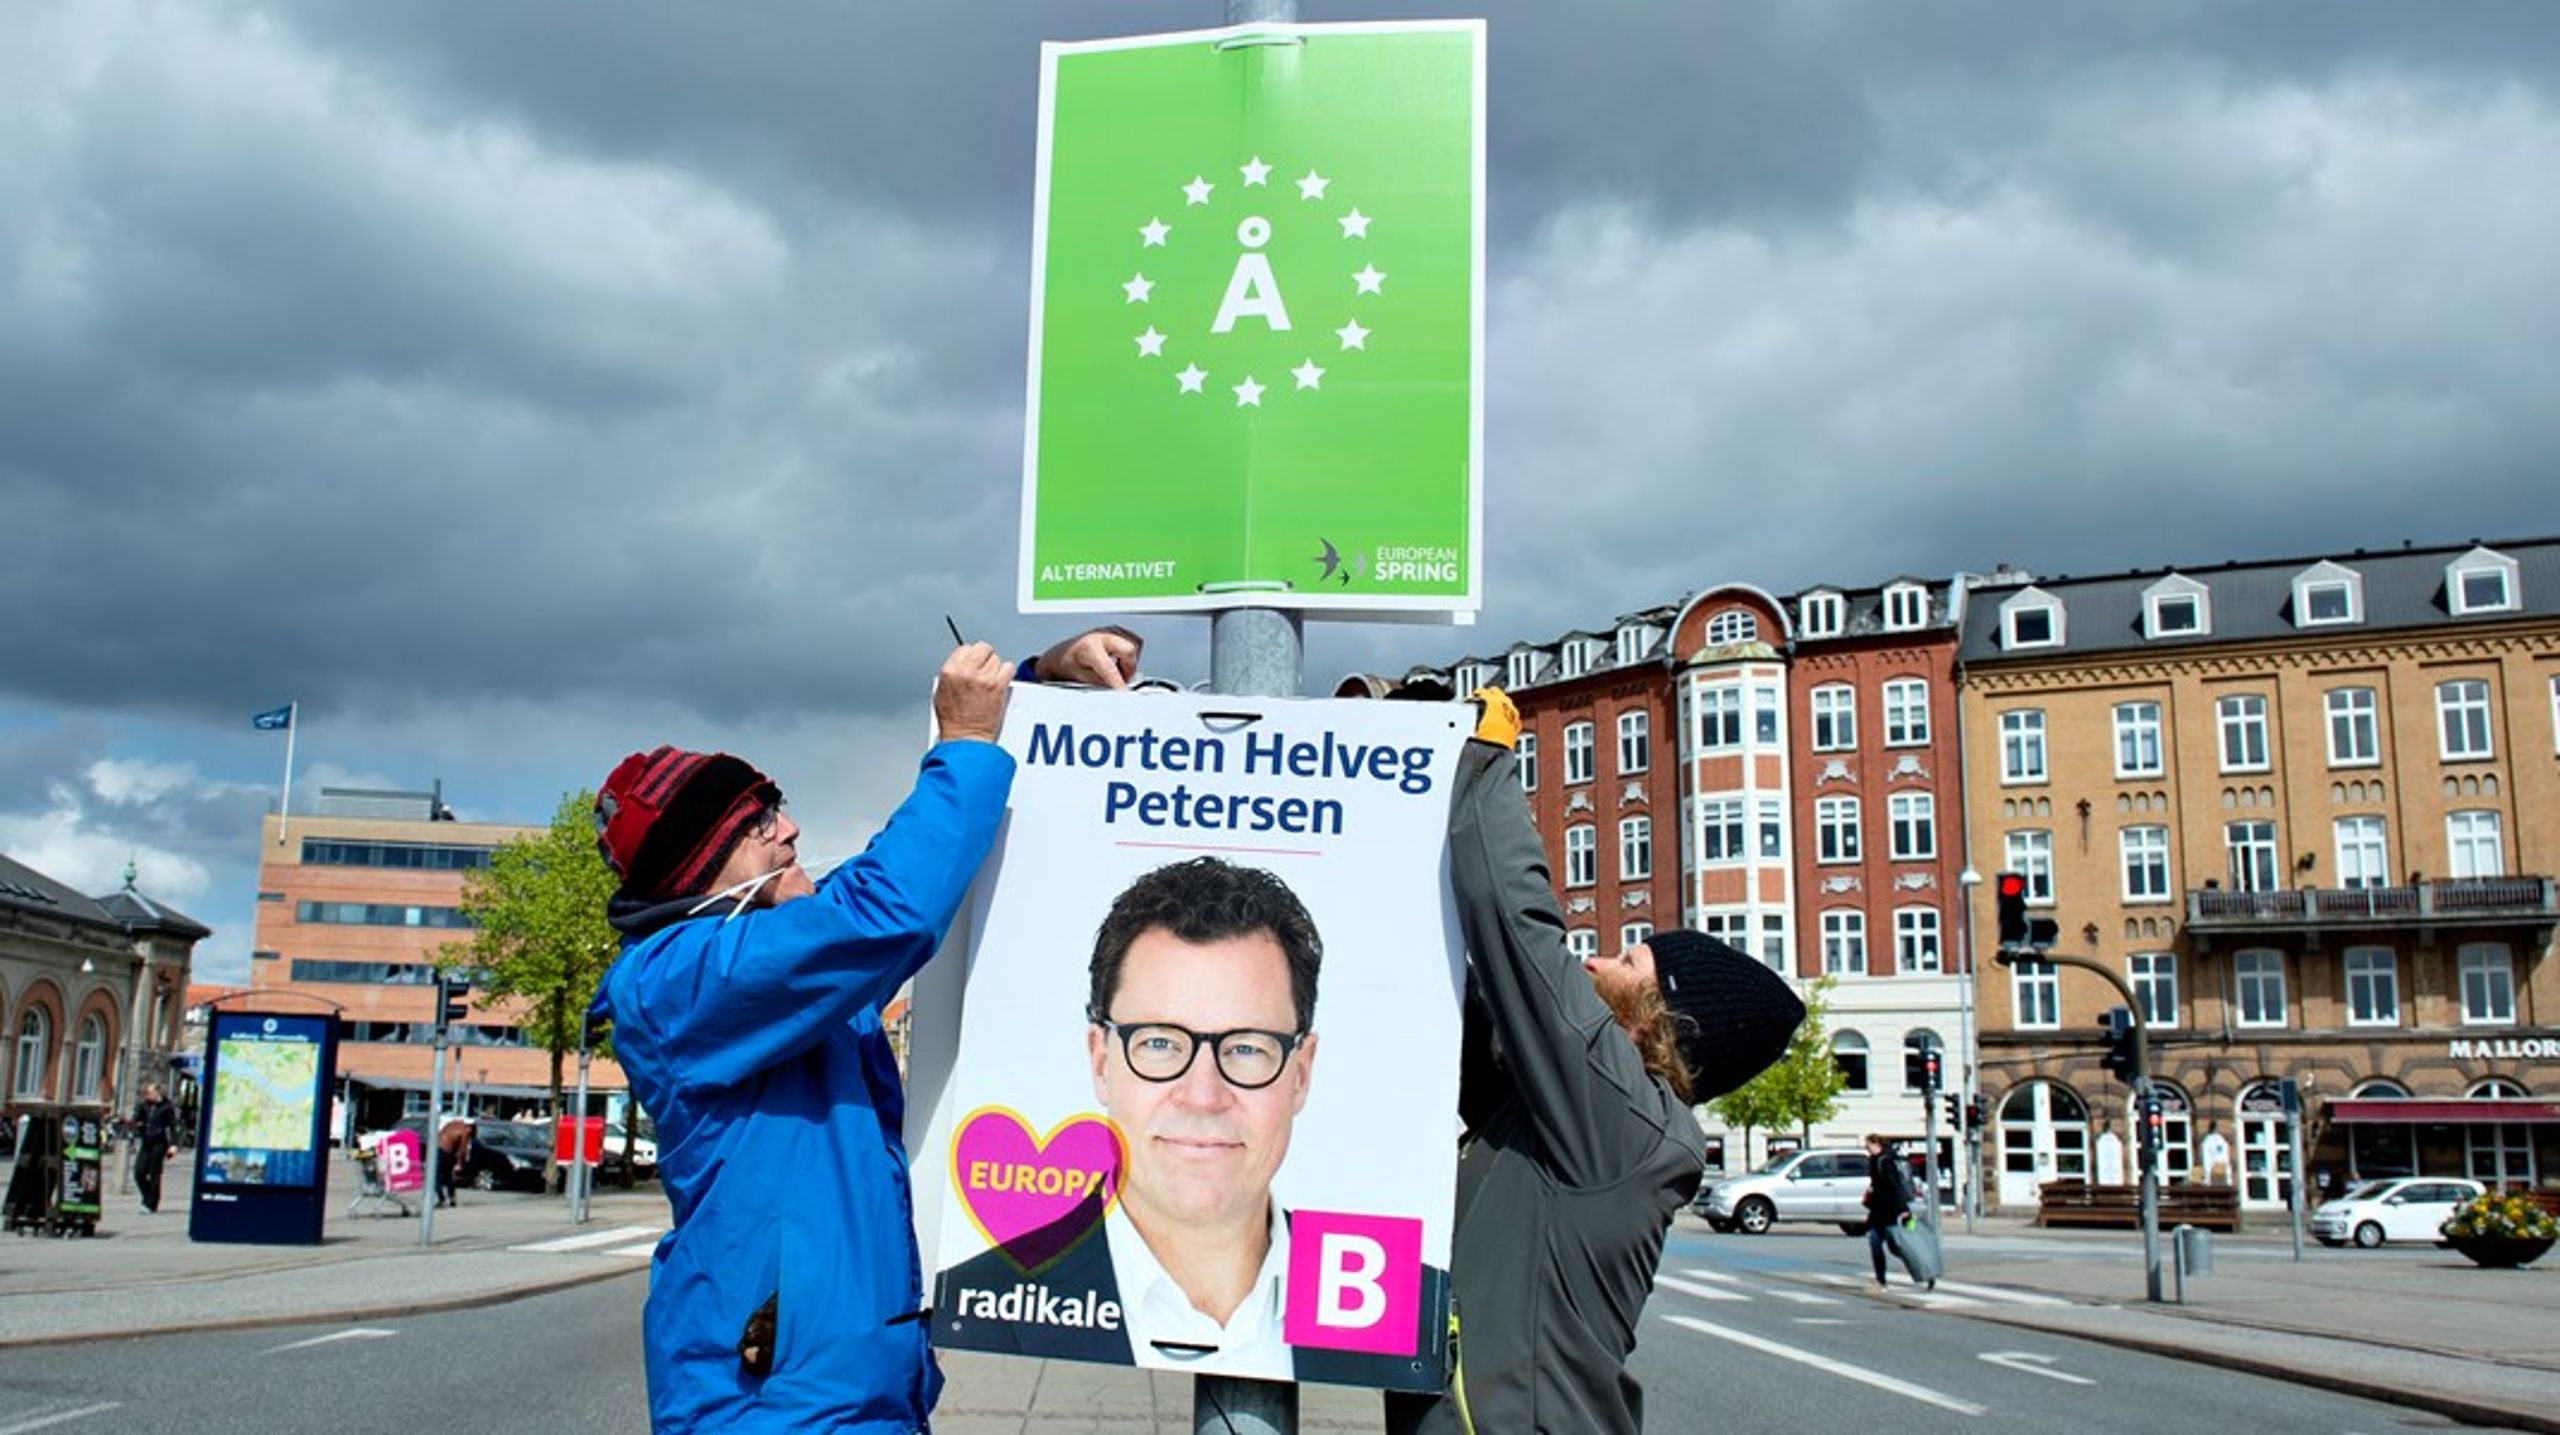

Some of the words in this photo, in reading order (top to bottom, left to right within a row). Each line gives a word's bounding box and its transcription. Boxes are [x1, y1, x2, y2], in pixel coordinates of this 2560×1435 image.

[1210, 215, 1292, 333] Å
[1041, 561, 1176, 582] ALTERNATIVET
[1375, 562, 1458, 582] SPRING
[1376, 546, 1458, 561] EUROPEAN
[1026, 723, 1223, 773] Morten
[1244, 731, 1434, 795] Helveg
[1104, 781, 1344, 835] Petersen
[388, 1143, 410, 1175] B
[969, 1160, 1108, 1199] EUROPA
[1316, 1233, 1387, 1329] B
[957, 1283, 1121, 1331] radikale
